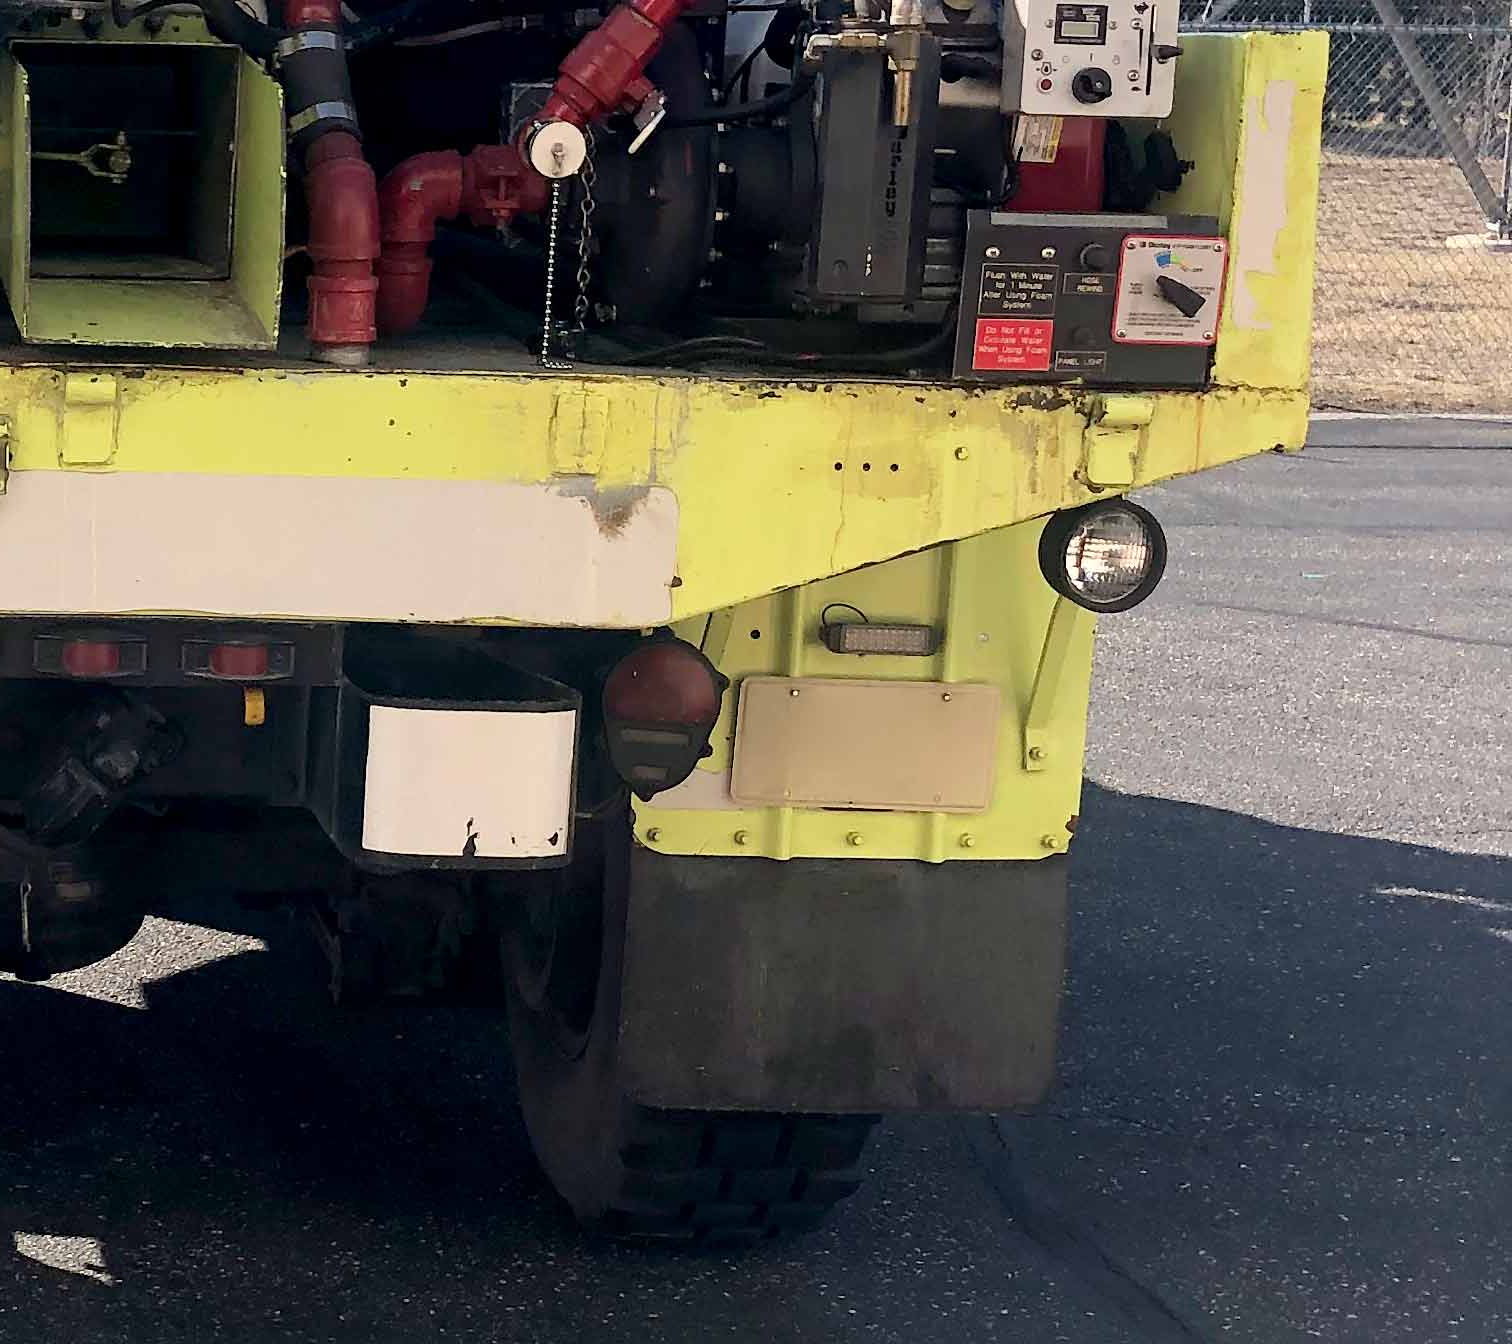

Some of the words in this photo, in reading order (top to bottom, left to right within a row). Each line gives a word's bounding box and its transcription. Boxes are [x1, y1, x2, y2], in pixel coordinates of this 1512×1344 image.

[985, 270, 1006, 280] Flush
[1010, 271, 1027, 280] With
[1031, 272, 1054, 281] Water
[995, 281, 1005, 289] for
[1018, 281, 1043, 289] Minute
[983, 290, 1001, 299] After
[1005, 290, 1027, 301] Using
[1030, 291, 1053, 300] Foam
[1002, 300, 1032, 310] System
[985, 326, 997, 334] Do
[1001, 327, 1015, 335] Not
[1018, 326, 1031, 335] Fill
[1021, 336, 1043, 345] Water
[978, 345, 999, 354] When
[1001, 346, 1023, 356] Using
[997, 356, 1026, 364] System
[1058, 357, 1080, 365] PANEL
[1083, 358, 1104, 366] LIGHT
